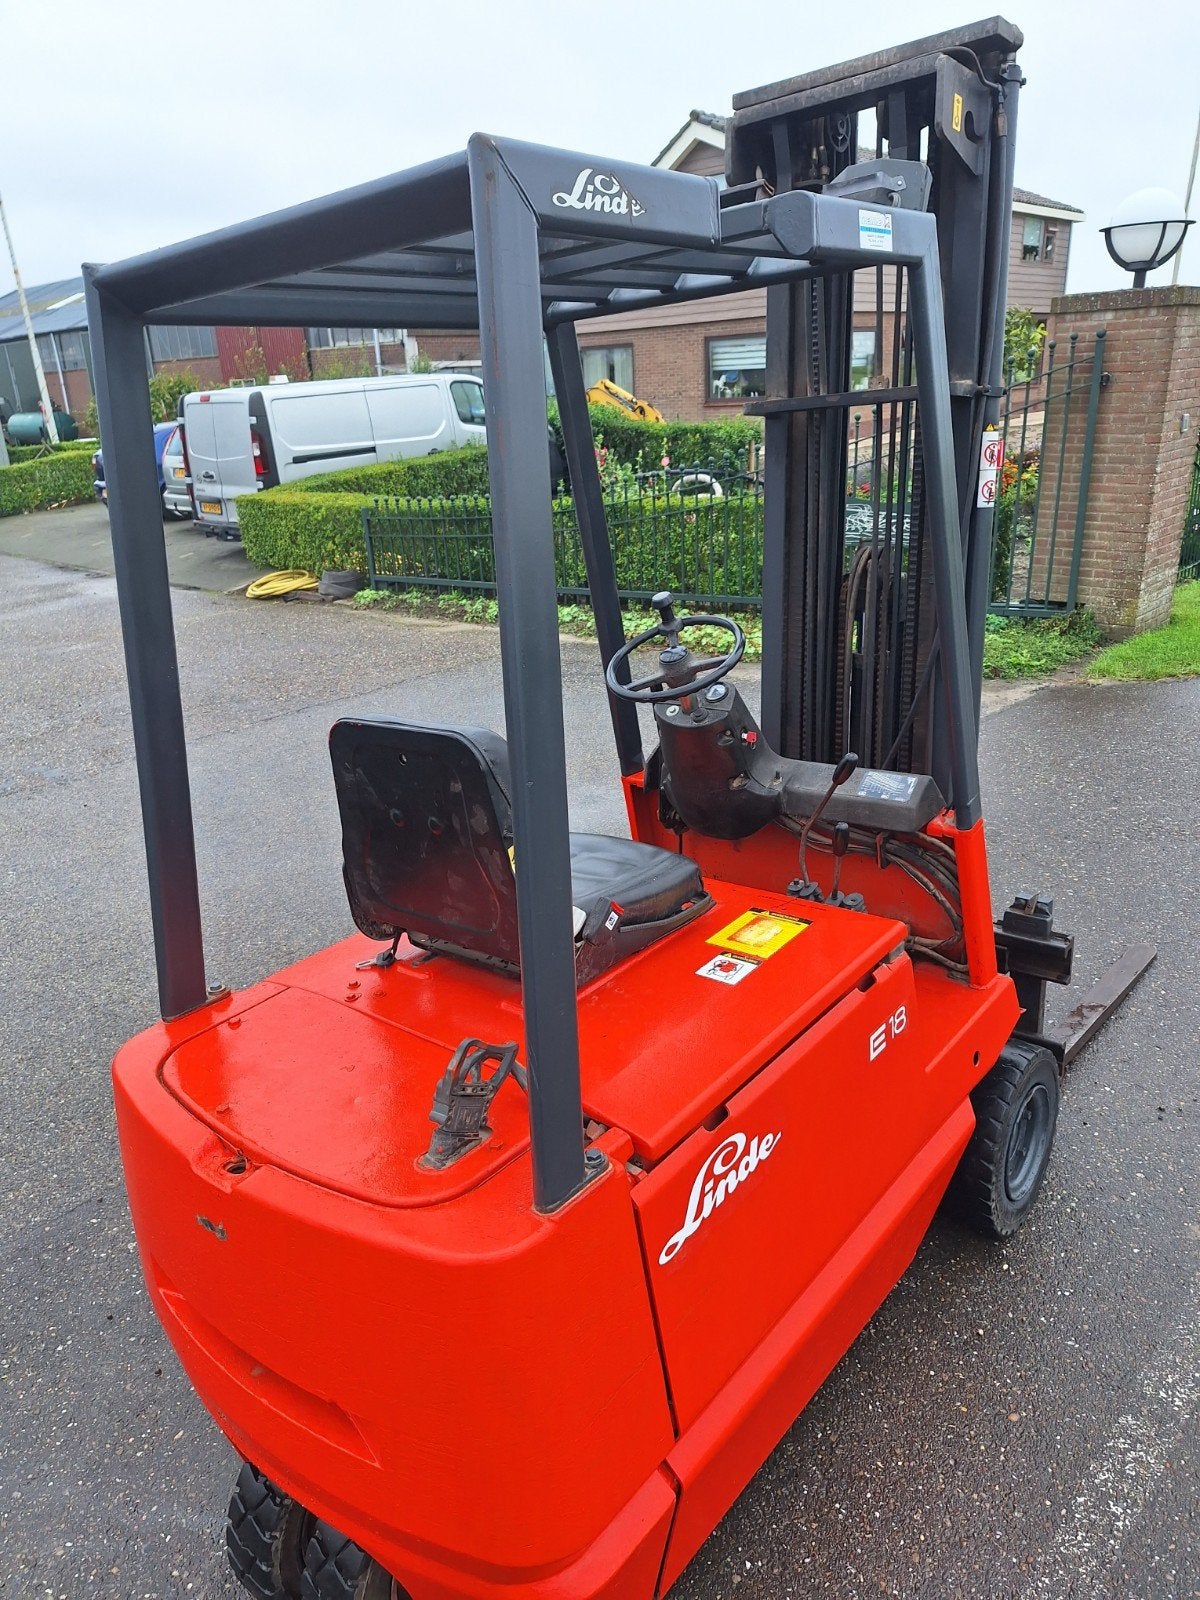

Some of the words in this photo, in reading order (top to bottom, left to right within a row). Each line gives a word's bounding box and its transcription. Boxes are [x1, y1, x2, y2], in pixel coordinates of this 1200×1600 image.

[552, 168, 646, 217] Linde
[869, 1023, 887, 1062] E
[888, 1005, 907, 1039] 18
[658, 1132, 782, 1265] Linde
